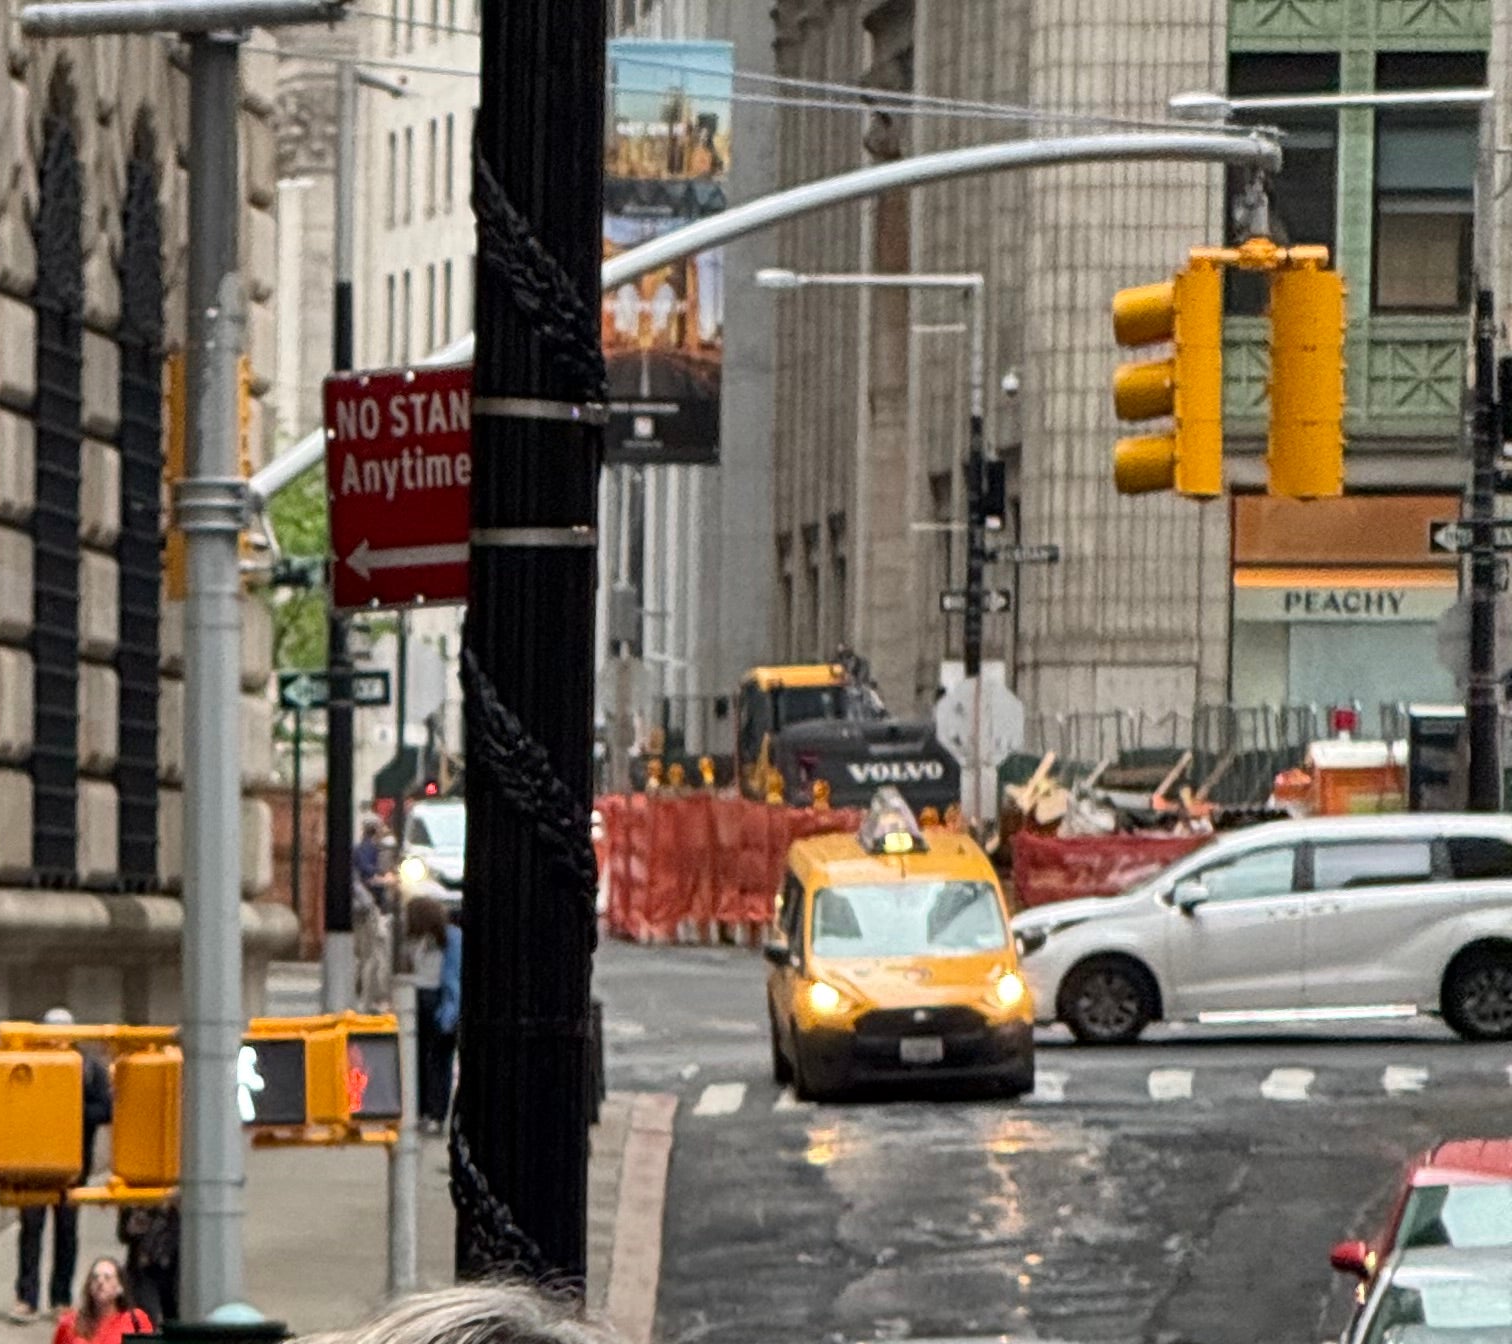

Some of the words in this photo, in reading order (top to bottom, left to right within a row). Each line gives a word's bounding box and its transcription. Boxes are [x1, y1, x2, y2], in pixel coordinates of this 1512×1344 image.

[336, 397, 380, 441] NO
[341, 445, 472, 503] Anytime
[1284, 588, 1405, 615] PEACHY
[847, 761, 944, 784] VOLVO
